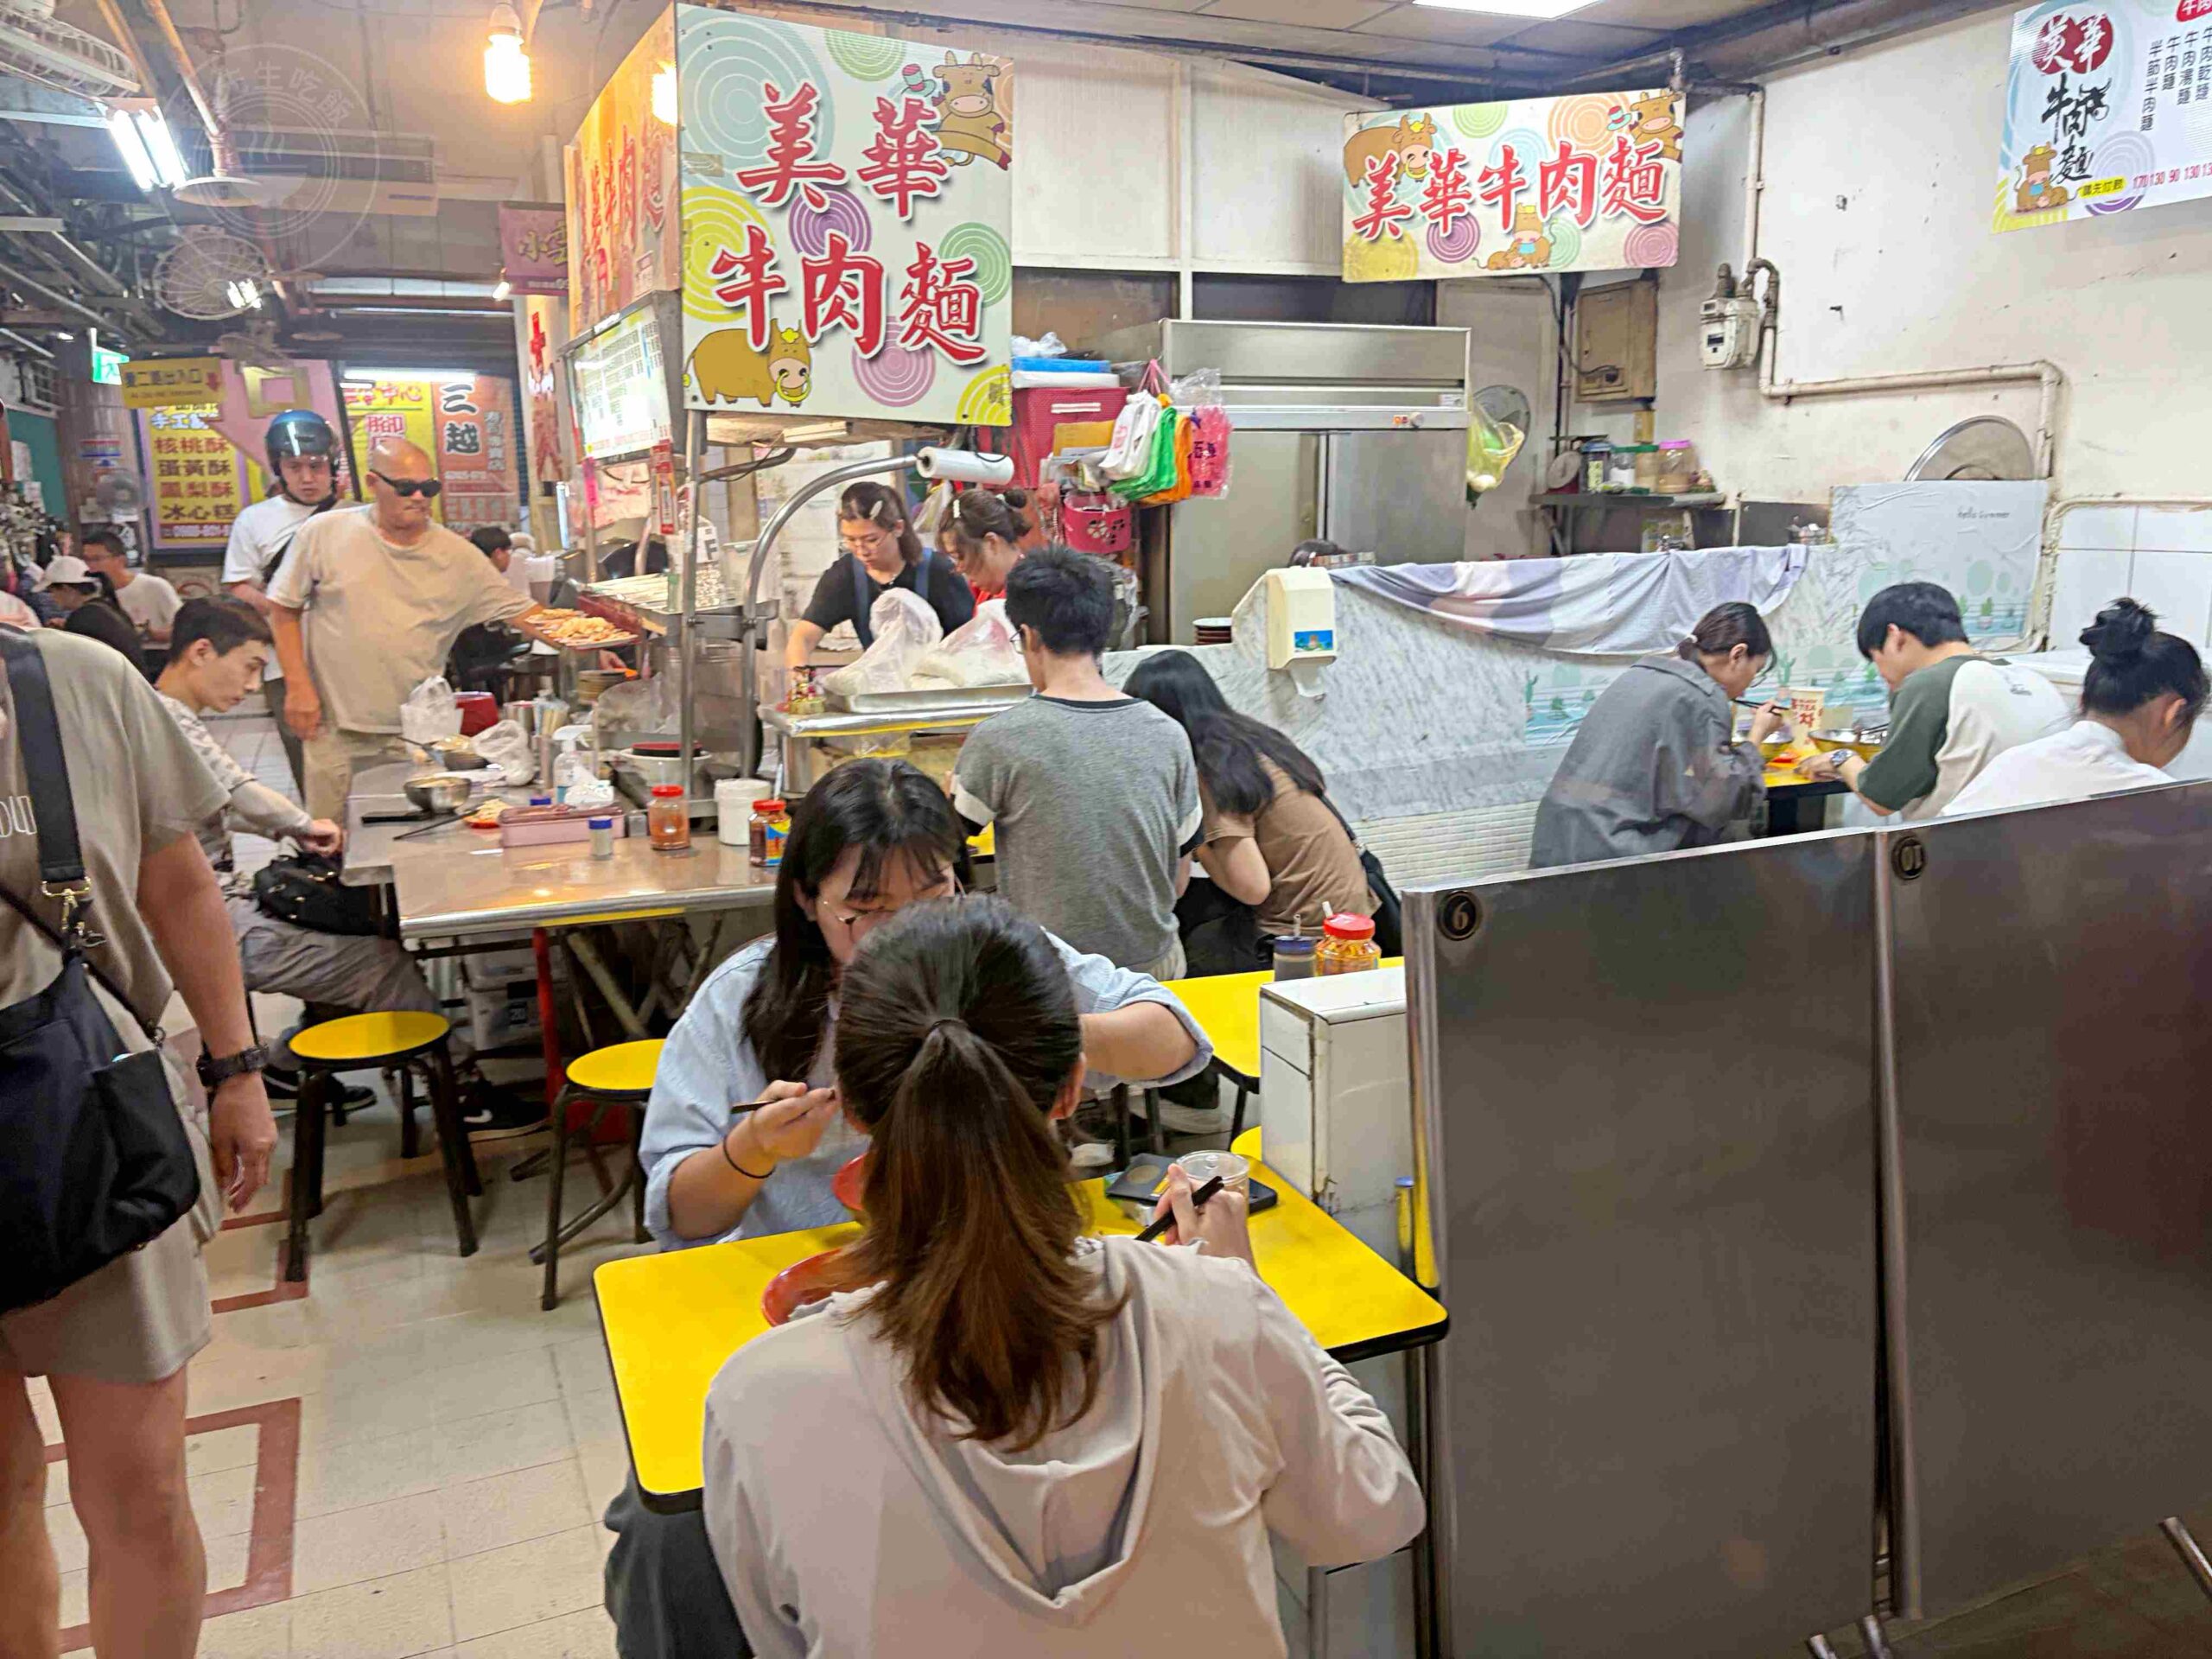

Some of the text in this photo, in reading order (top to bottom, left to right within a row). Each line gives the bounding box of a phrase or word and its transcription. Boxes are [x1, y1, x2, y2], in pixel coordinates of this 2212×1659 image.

[738, 84, 948, 218] 美華
[1353, 137, 1668, 238] 美華牛肉麵
[712, 227, 987, 364] 牛肉麵
[154, 436, 228, 454] 核桃酥
[442, 384, 480, 454] 三越
